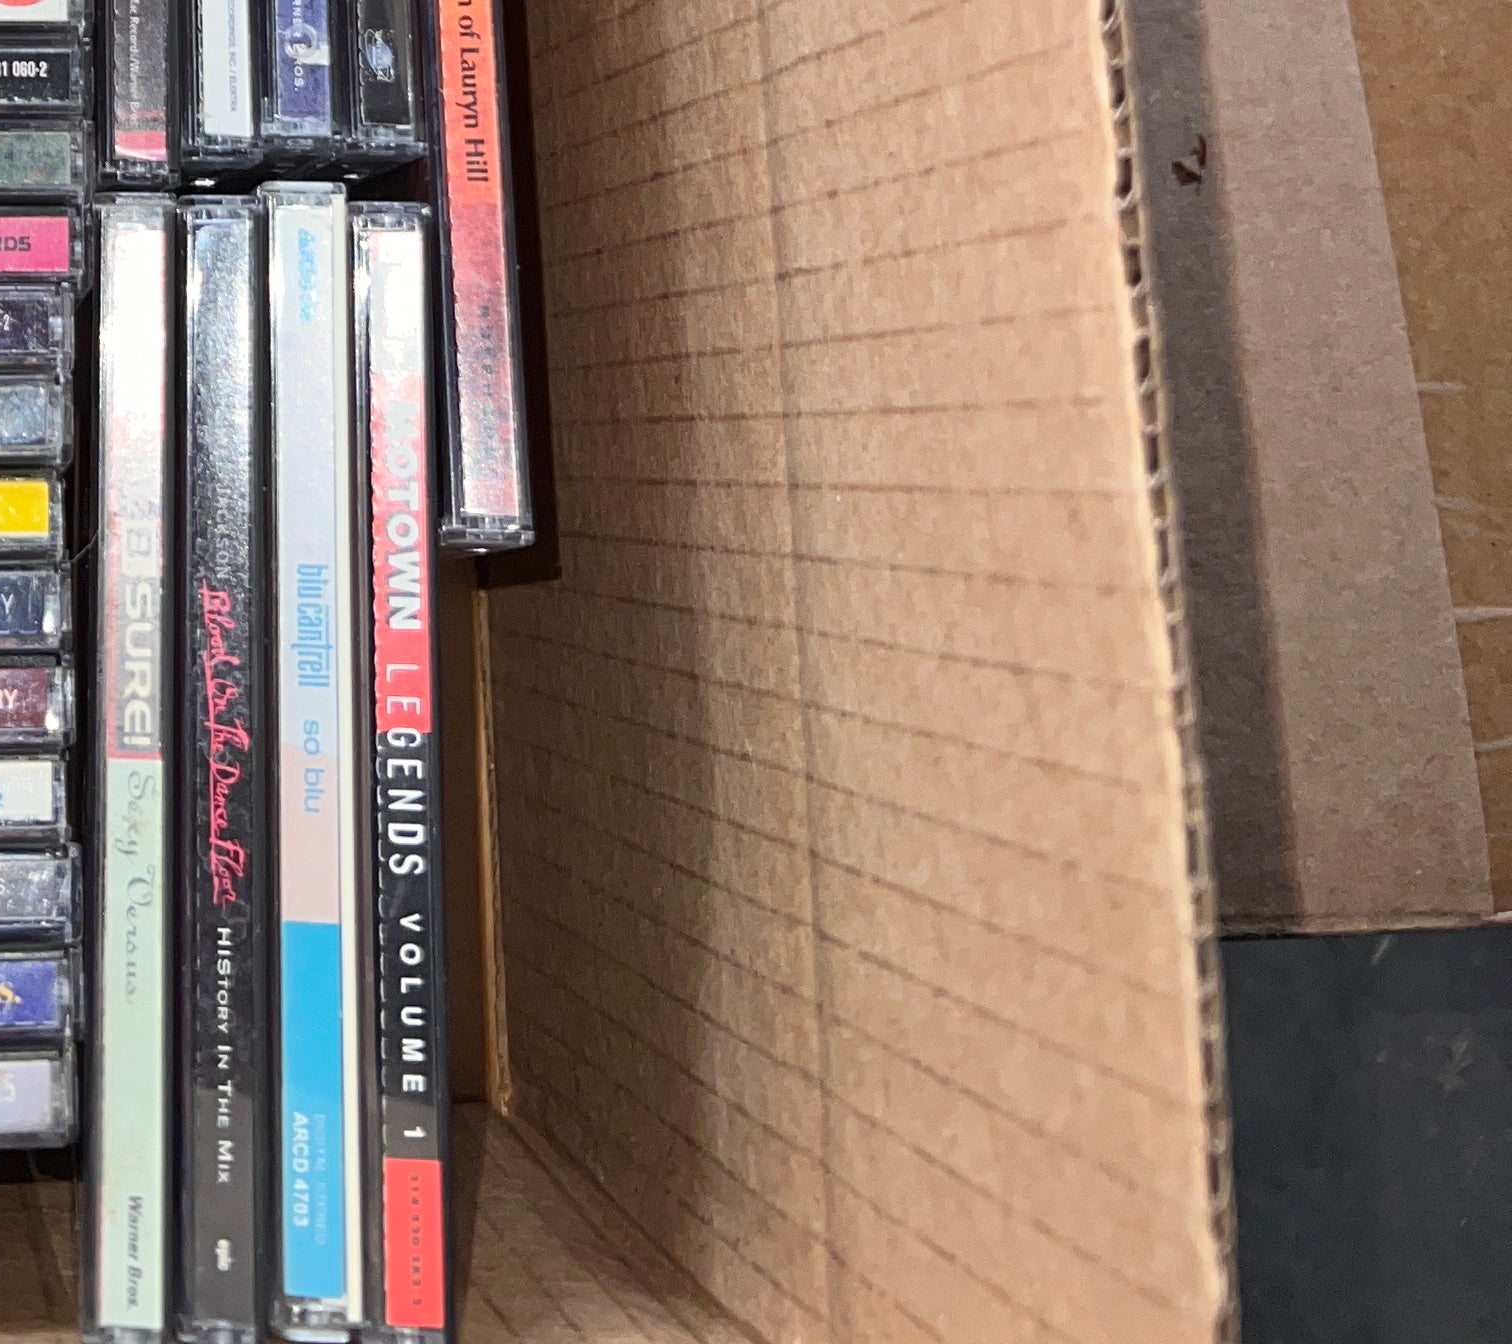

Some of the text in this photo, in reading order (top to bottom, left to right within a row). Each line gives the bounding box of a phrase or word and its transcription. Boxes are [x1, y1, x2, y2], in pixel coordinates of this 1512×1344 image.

[456, 47, 489, 183] Lauryn Hill
[210, 757, 242, 837] Dance
[123, 583, 152, 1260] SURE! Warner
[385, 663, 425, 1093] LEGENDS VOLUME
[292, 1111, 310, 1227] ARCD 4703
